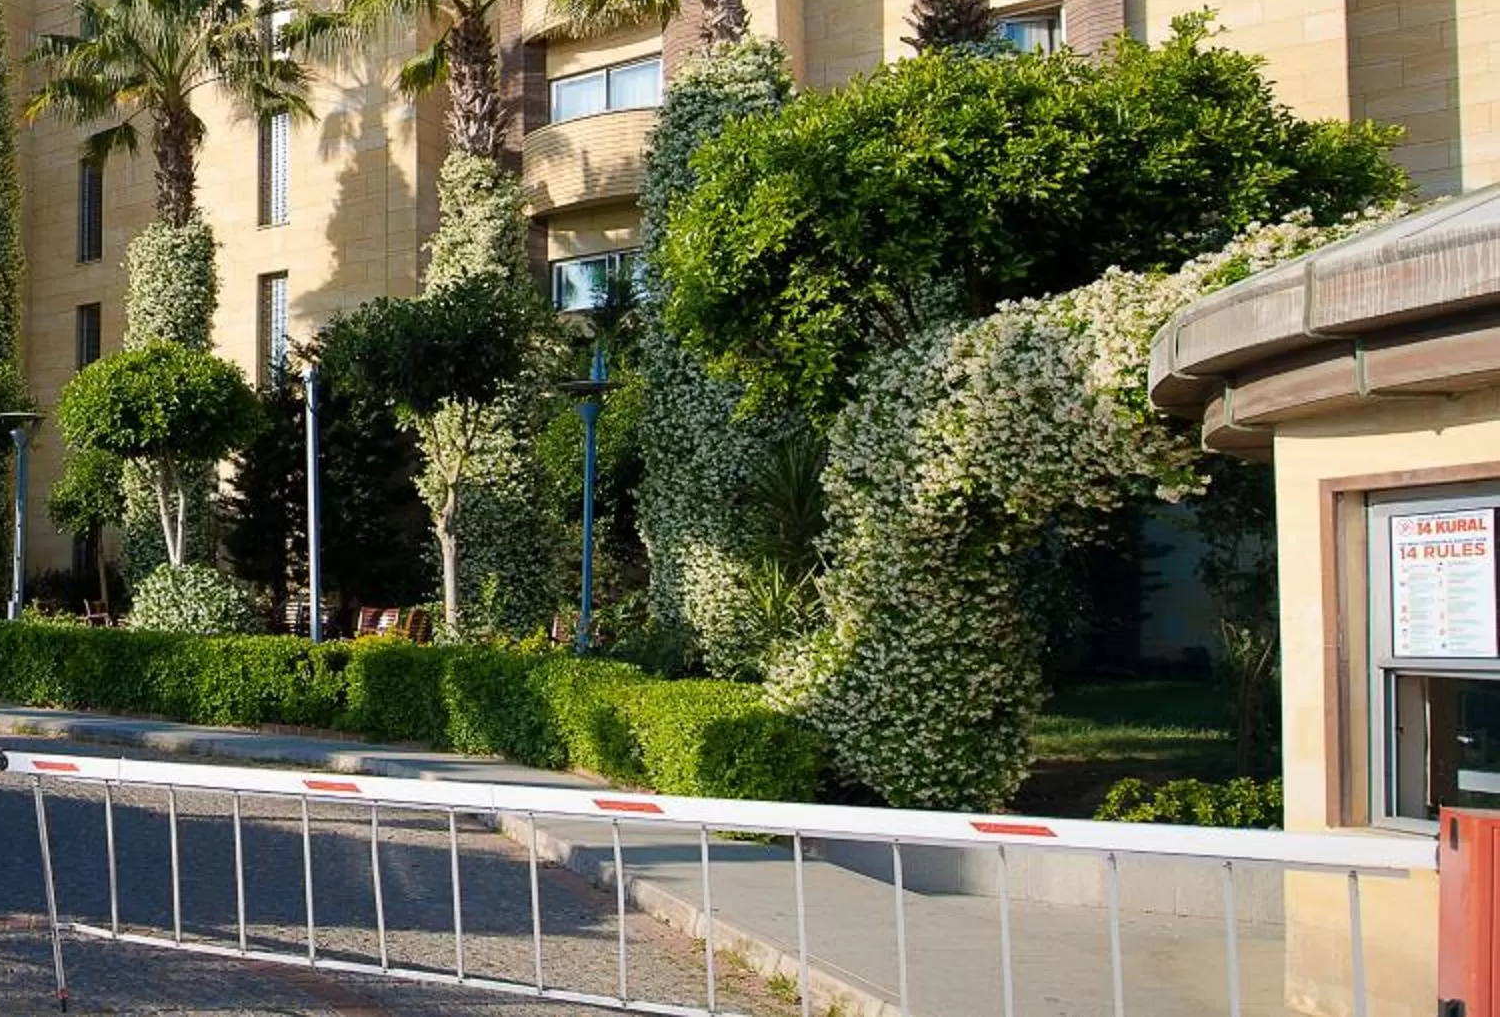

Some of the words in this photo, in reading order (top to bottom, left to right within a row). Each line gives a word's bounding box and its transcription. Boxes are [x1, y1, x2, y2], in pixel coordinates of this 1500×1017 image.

[1436, 518, 1487, 533] KURAL
[1400, 546, 1417, 559] 14
[1424, 542, 1485, 558] RULES
